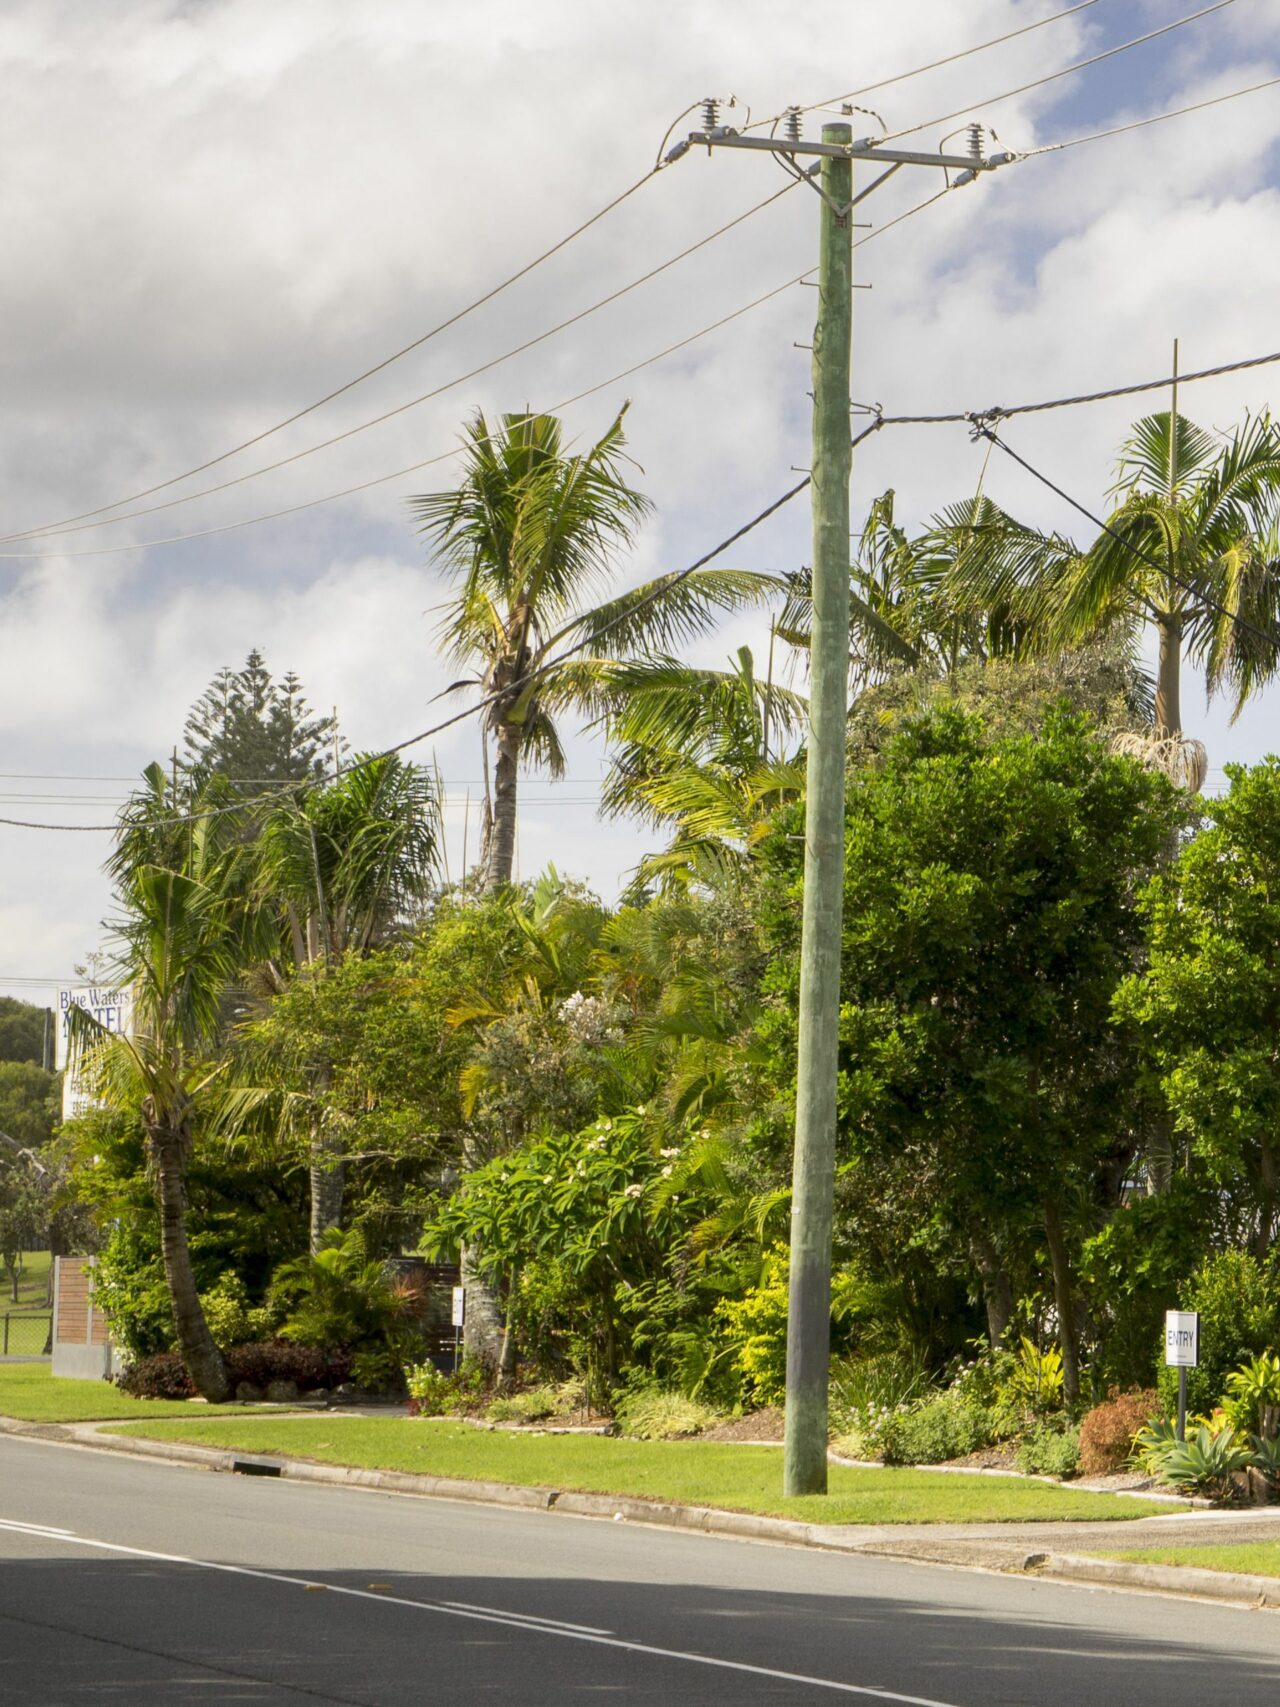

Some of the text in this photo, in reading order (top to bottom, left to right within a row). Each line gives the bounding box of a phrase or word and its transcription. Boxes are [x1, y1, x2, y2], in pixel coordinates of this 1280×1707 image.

[60, 988, 130, 1009] Blue Waters
[1168, 1330, 1194, 1347] ENTRY
